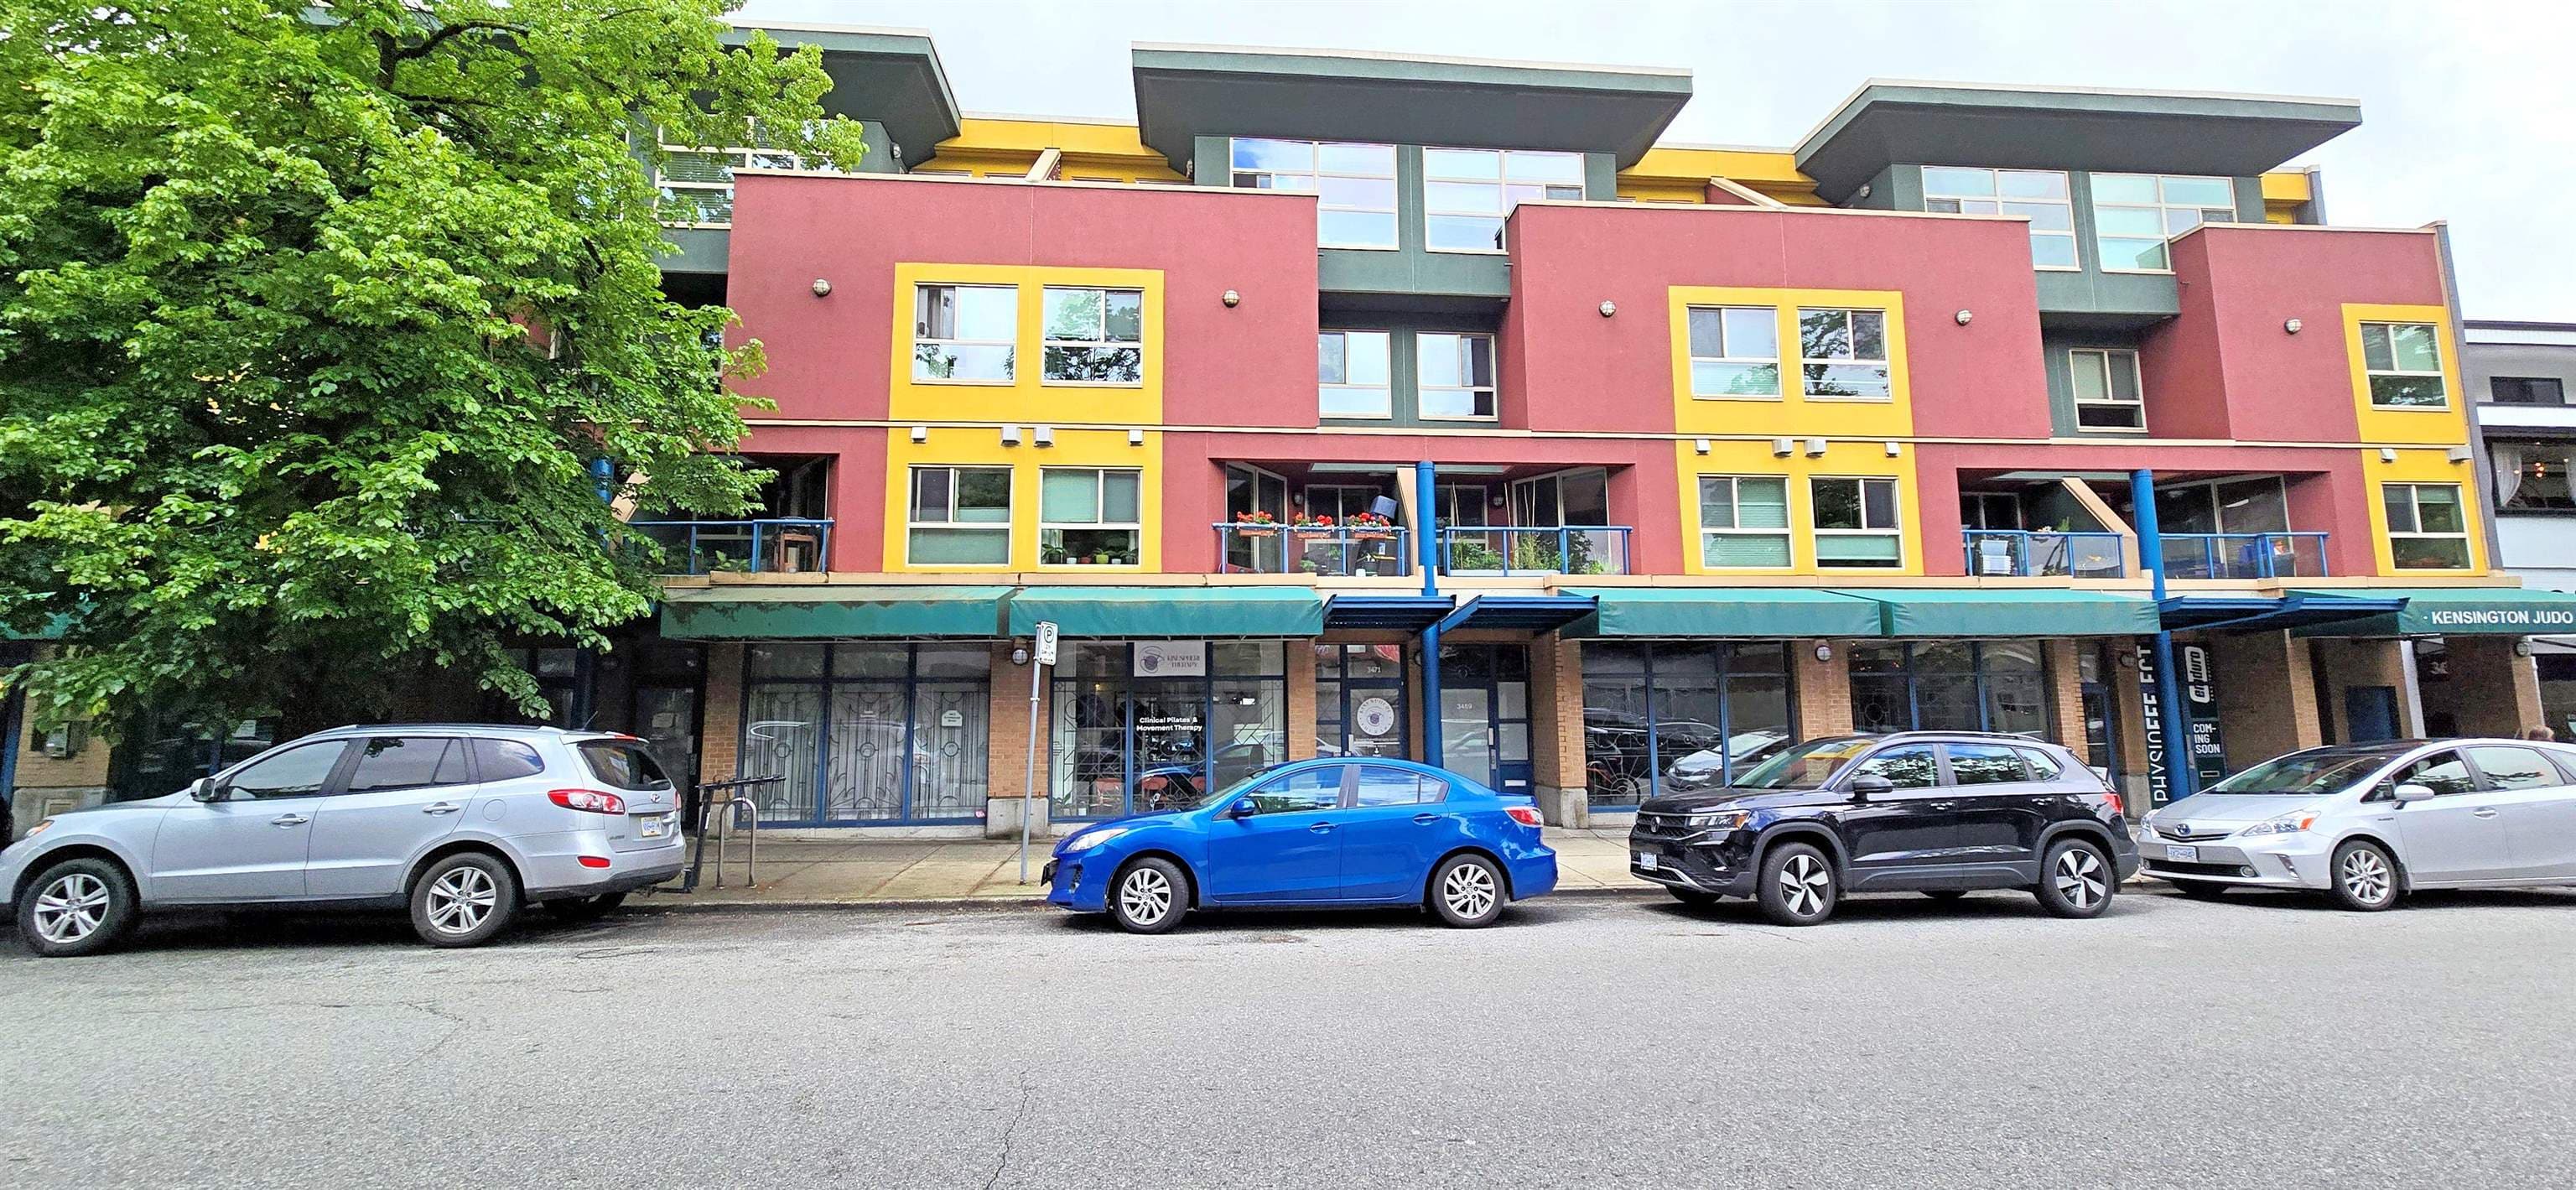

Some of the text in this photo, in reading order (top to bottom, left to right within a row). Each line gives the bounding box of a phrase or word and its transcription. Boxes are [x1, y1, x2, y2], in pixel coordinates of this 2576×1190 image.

[2431, 611, 2573, 625] KENSINGTON JUDO
[2193, 723, 2217, 734] COM-
[2194, 733, 2210, 744] ING
[2194, 743, 2221, 754] SOON
